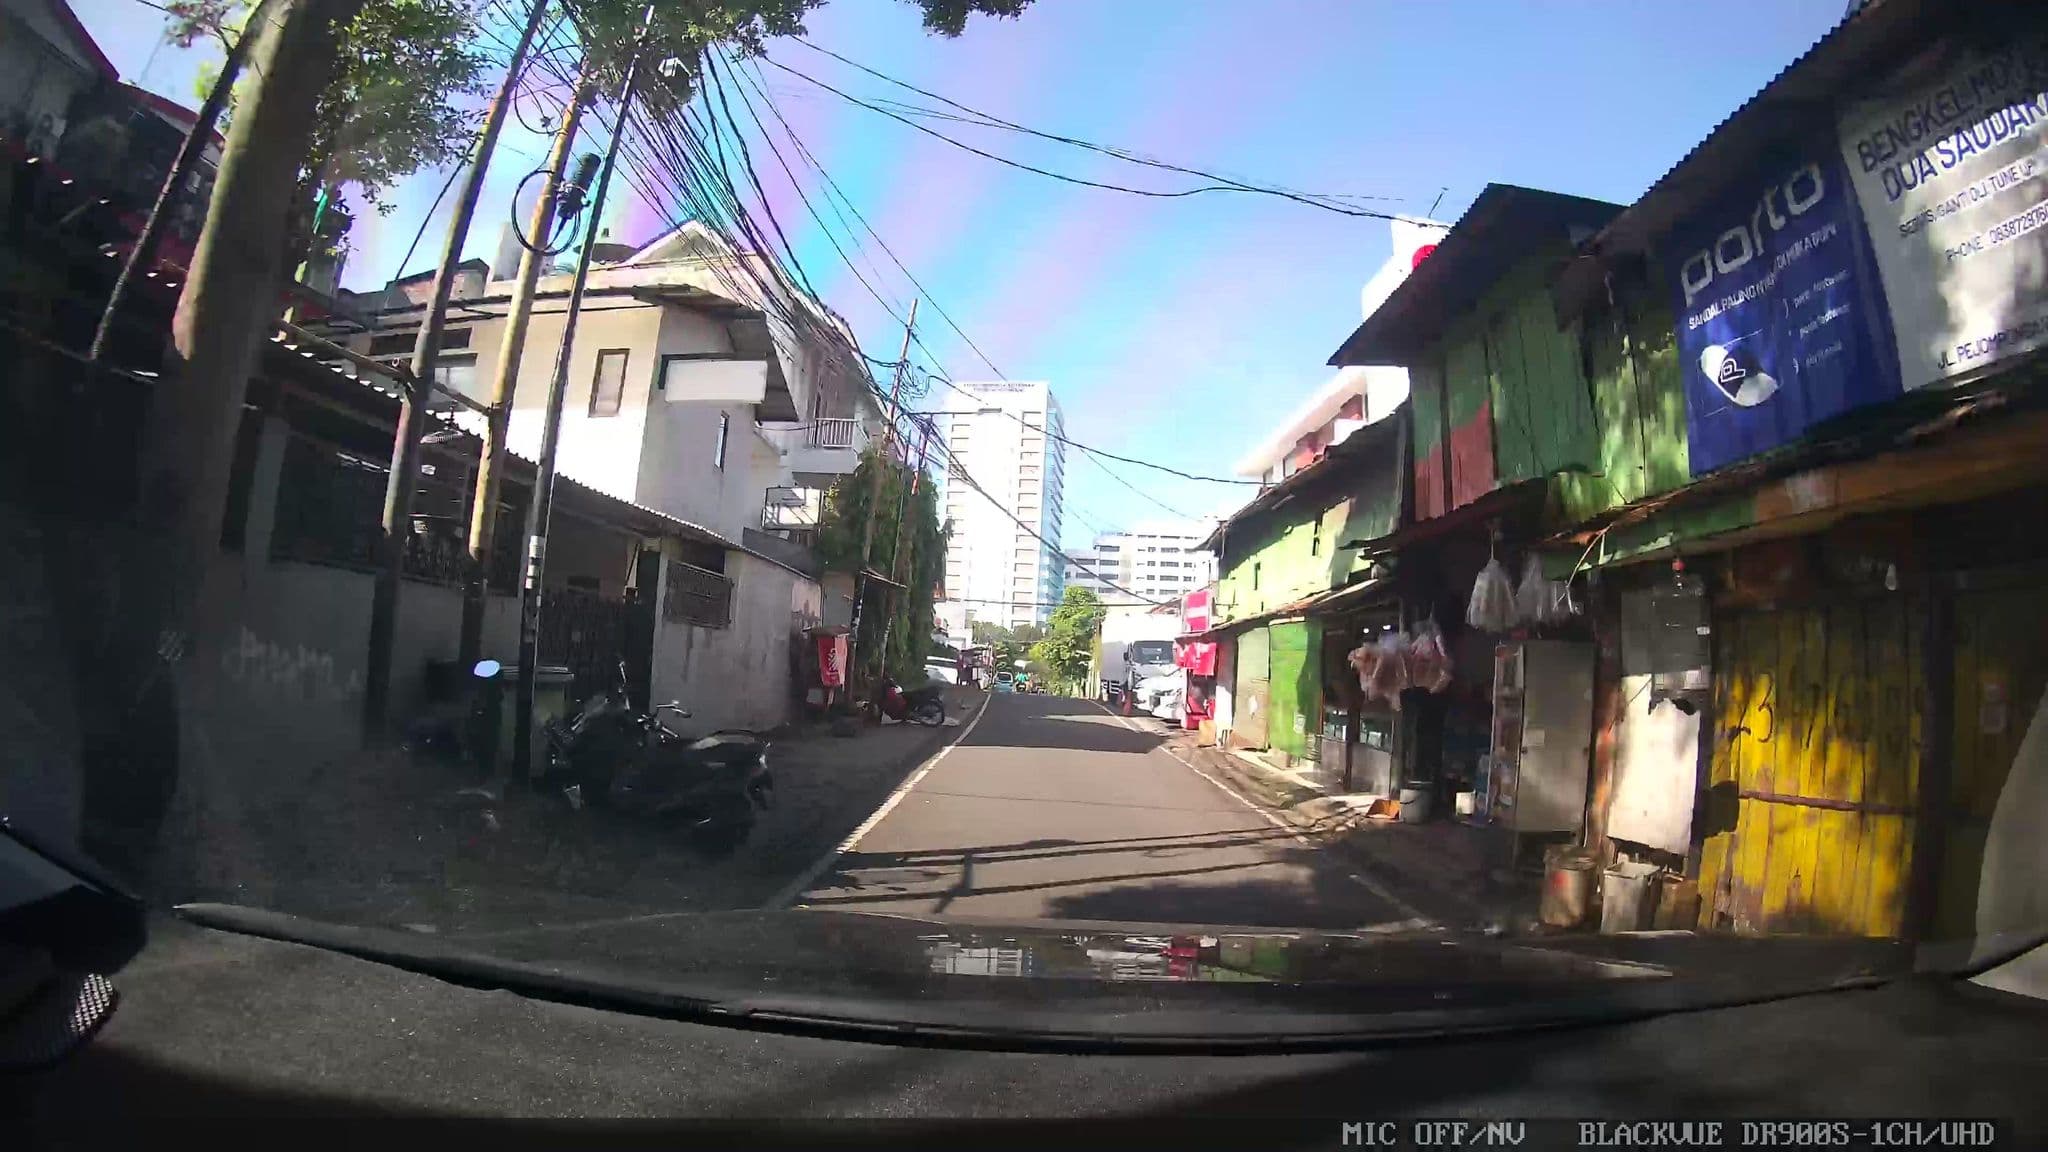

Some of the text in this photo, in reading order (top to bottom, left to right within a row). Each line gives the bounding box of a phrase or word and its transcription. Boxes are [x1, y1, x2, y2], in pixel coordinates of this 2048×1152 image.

[1857, 85, 1975, 173] BENGKEL
[1881, 149, 1938, 202] DUA
[1988, 165, 2021, 192] TUNE
[1680, 162, 1826, 308] porto
[1688, 301, 1723, 330] SANDAL
